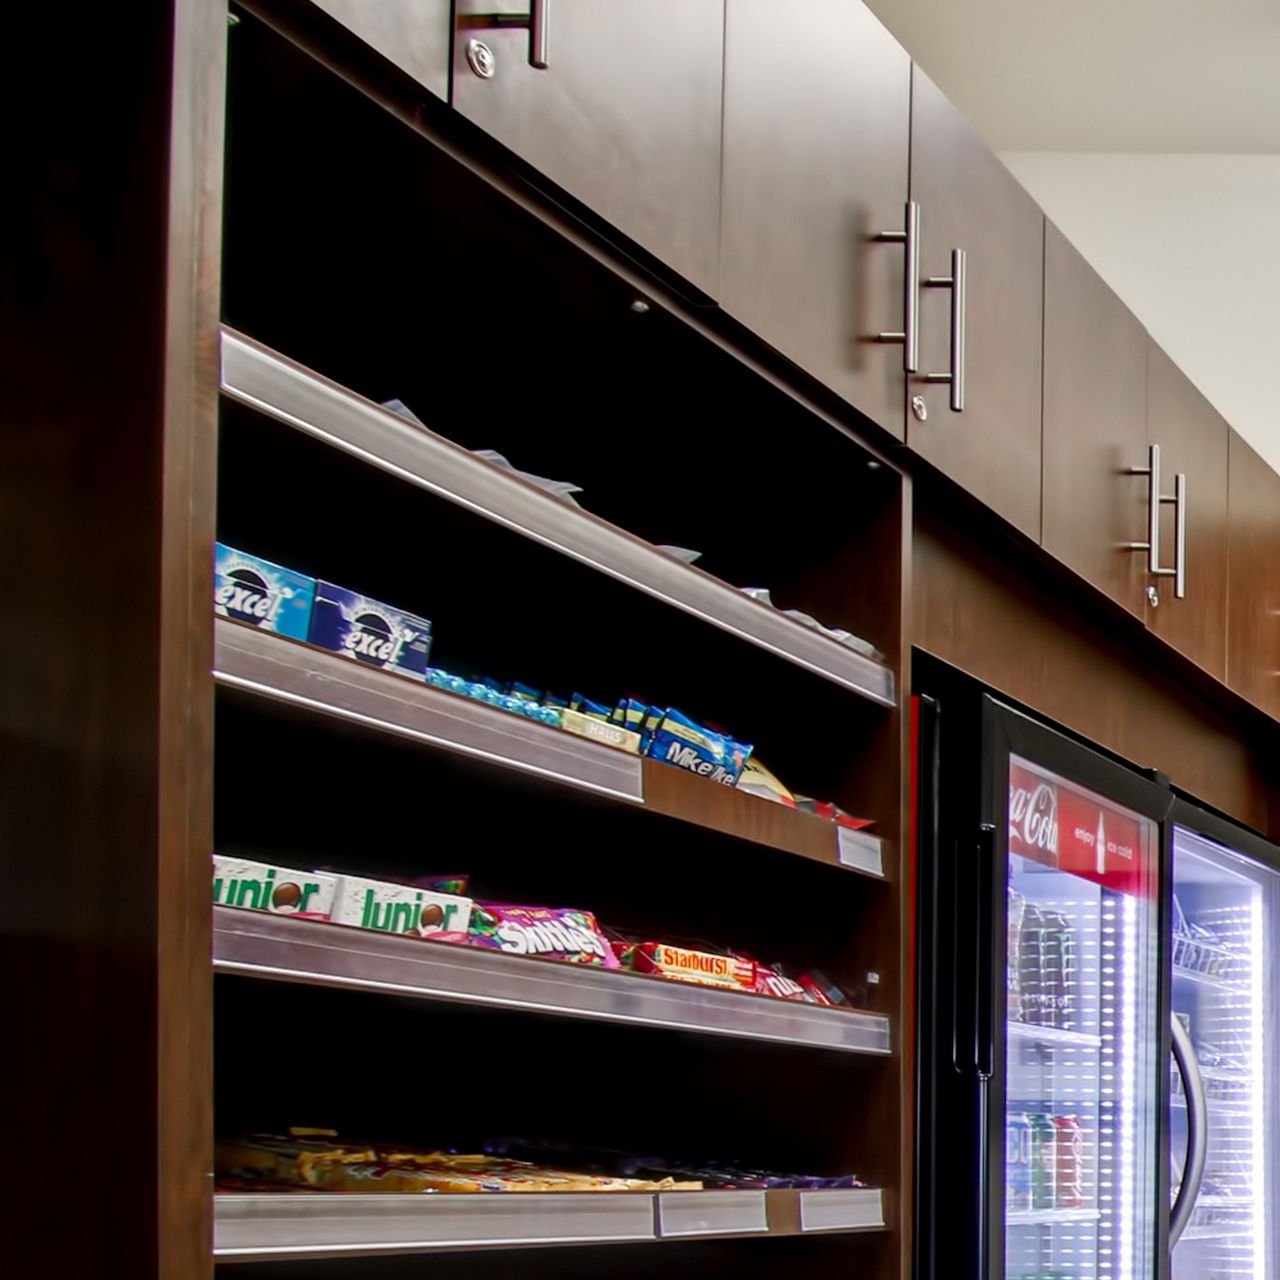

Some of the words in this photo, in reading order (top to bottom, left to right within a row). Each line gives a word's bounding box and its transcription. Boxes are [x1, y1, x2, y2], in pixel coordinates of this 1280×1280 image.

[215, 585, 281, 621] excel
[345, 629, 401, 663] excel
[588, 722, 621, 743] HALLS
[665, 741, 711, 775] Mike
[213, 869, 320, 912] unior
